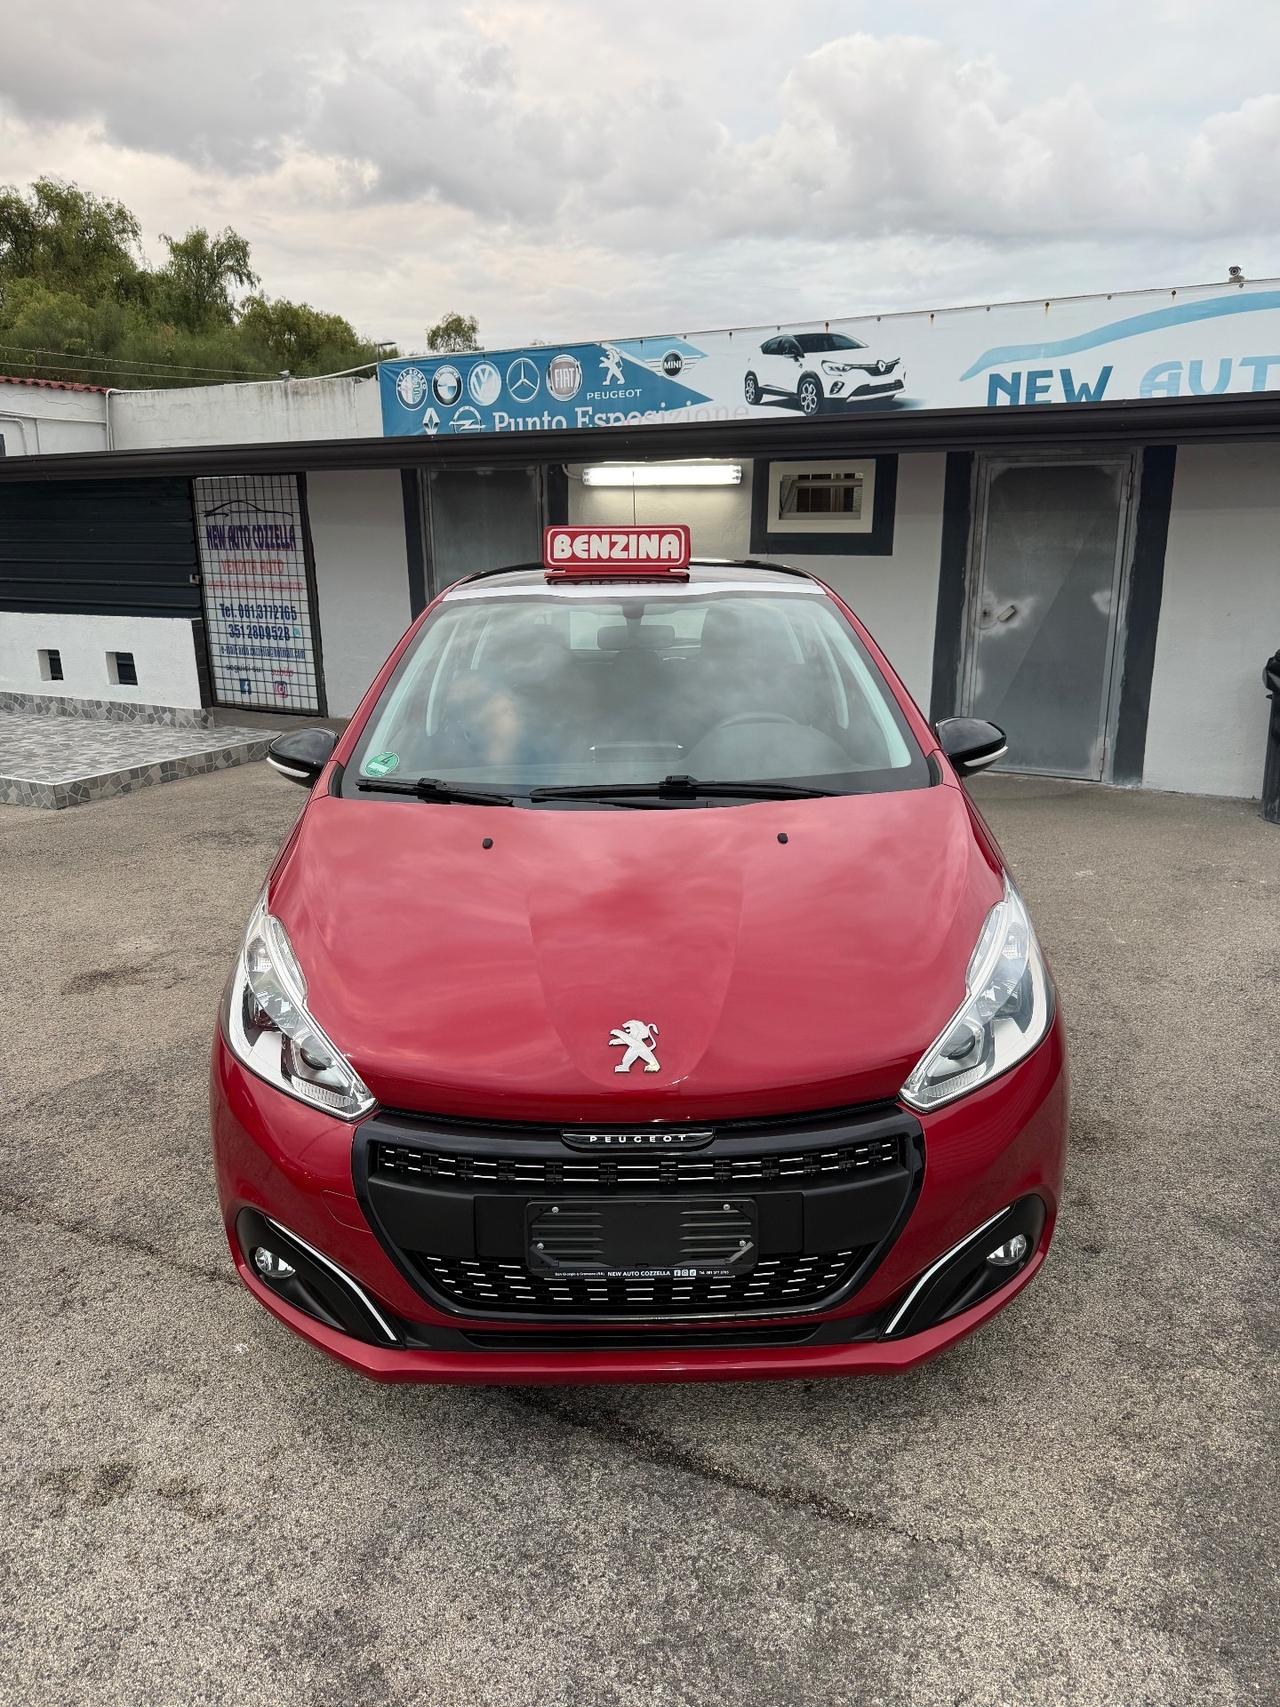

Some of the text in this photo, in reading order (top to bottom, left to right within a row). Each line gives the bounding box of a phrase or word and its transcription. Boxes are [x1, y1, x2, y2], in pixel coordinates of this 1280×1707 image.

[663, 360, 683, 370] MINI
[554, 367, 576, 389] FIAT
[986, 366, 1113, 407] NEW
[586, 388, 643, 400] PEUGEOT
[492, 410, 567, 433] Punto
[252, 525, 297, 552] COZZELLA
[553, 533, 680, 560] BENZINA
[219, 603, 237, 618] Tel.
[589, 1134, 687, 1144] PEUGEOT
